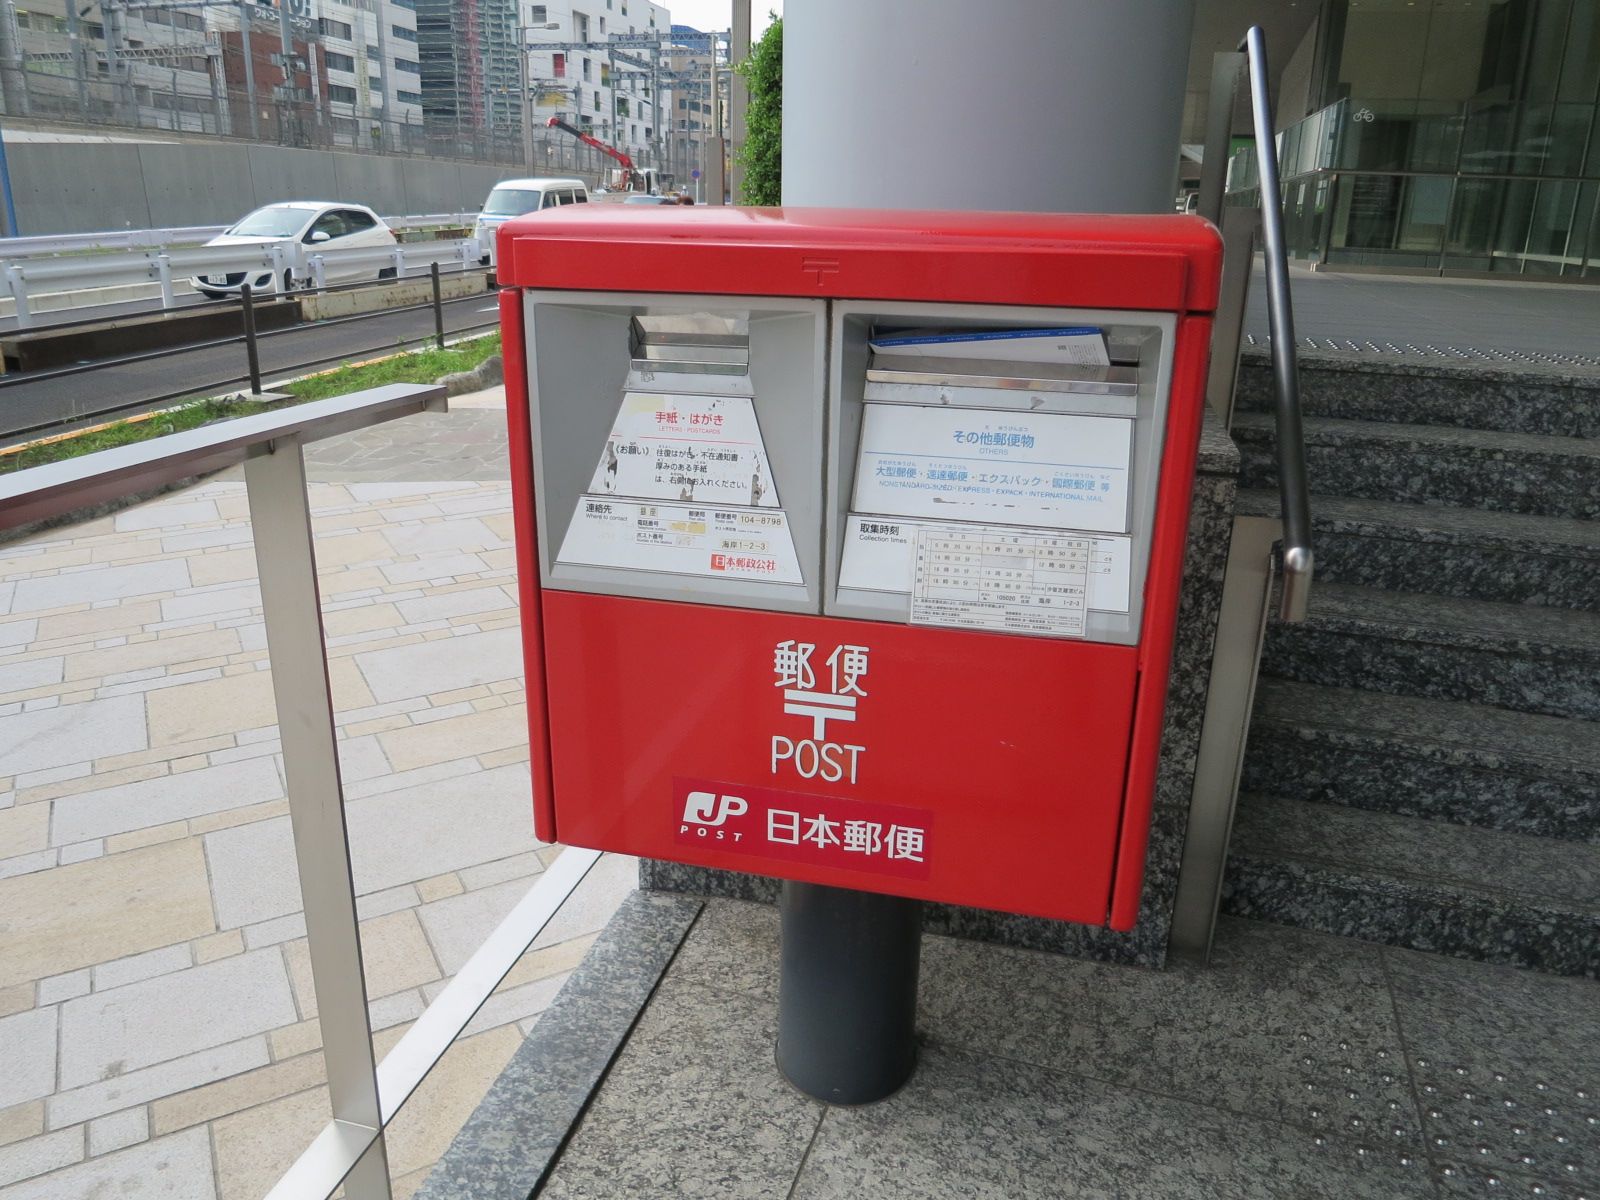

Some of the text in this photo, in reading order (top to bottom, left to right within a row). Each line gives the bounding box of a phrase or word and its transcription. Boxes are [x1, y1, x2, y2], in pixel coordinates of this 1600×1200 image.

[655, 411, 723, 426] 手紙・はがき
[953, 430, 1035, 449] その他郵便物
[979, 447, 1009, 456] OTHERS
[586, 503, 613, 514] 連絡先
[860, 523, 899, 536] 取集時刻
[859, 534, 889, 542] Collection
[773, 639, 870, 697] 郵便
[771, 735, 866, 785] POST
[680, 825, 742, 842] POST
[767, 808, 925, 863] 日本郵便
